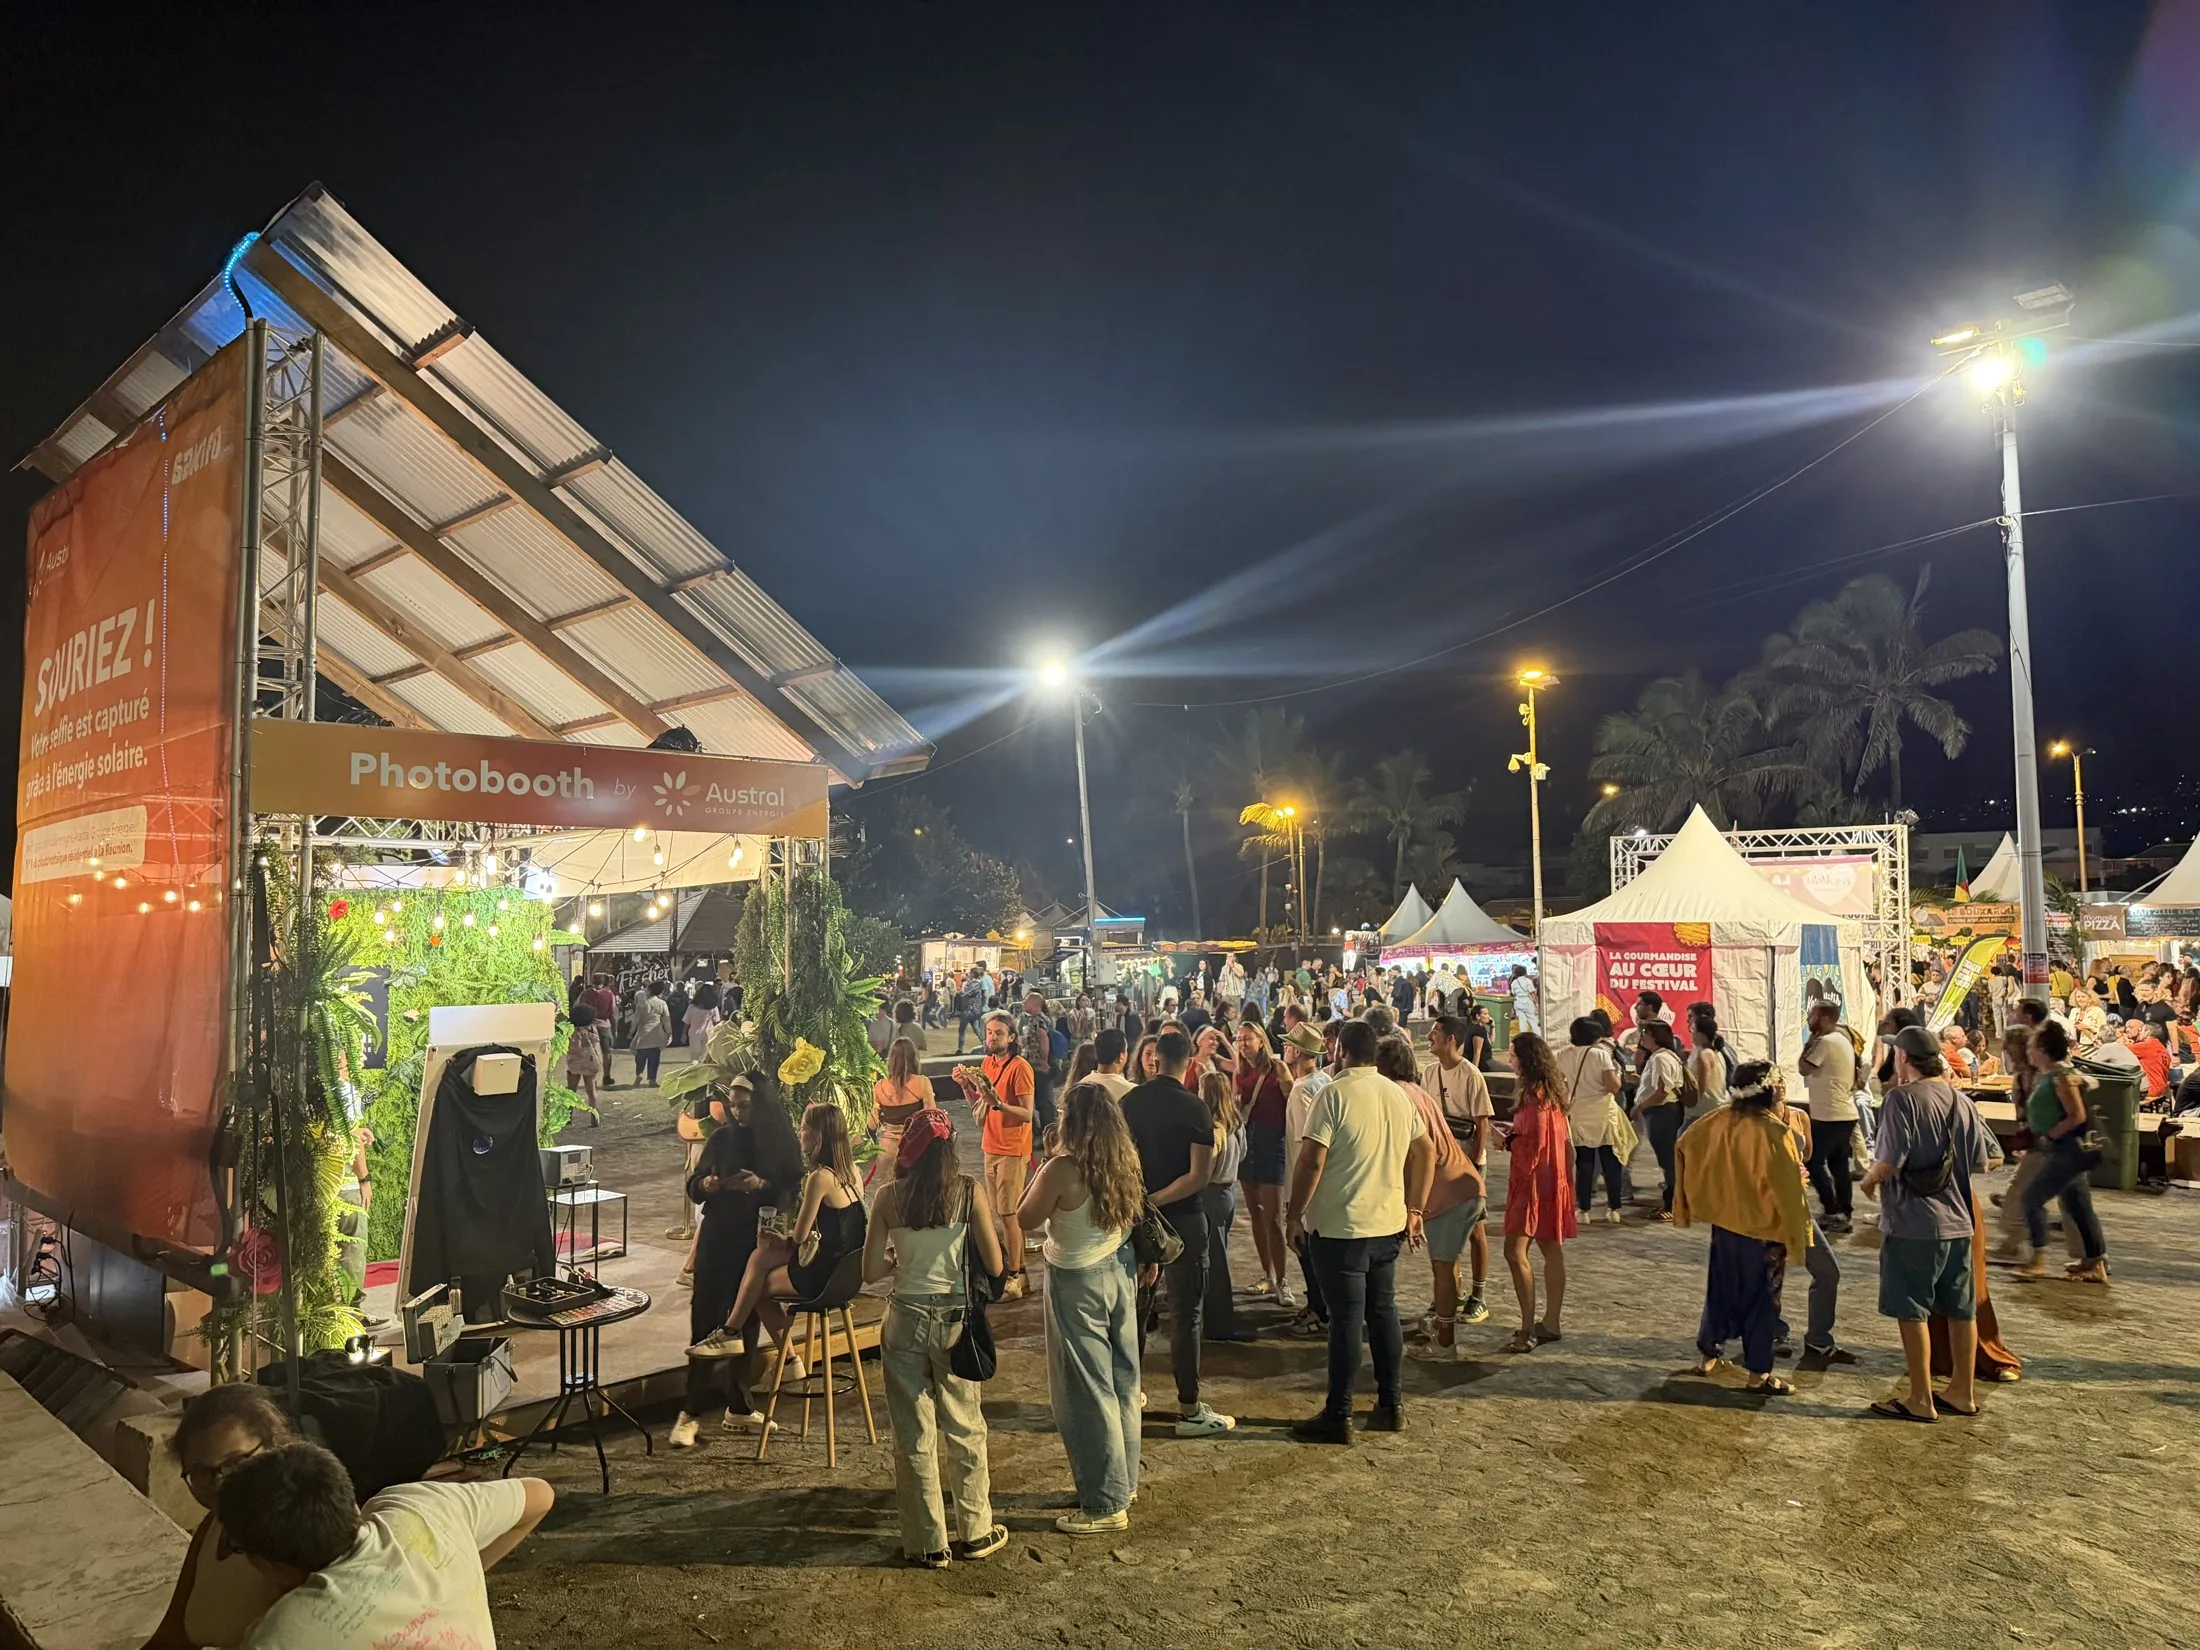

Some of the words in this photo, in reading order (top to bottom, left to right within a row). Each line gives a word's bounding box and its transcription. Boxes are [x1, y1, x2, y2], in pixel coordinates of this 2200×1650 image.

[34, 606, 138, 718] SOURIEZ
[50, 714, 74, 750] selfie
[76, 709, 93, 739] est
[95, 687, 150, 738] capturé
[52, 751, 95, 791] l'énergie
[97, 740, 149, 778] solaire.
[350, 751, 595, 801] Photobooth
[614, 777, 637, 800] by
[705, 782, 785, 807] Austral
[704, 806, 743, 816] GROUPE
[2084, 919, 2121, 931] PIZZA
[1609, 952, 1622, 960] LA
[1623, 952, 1698, 961] GOURMANDISE
[1609, 962, 1636, 977] AU
[1640, 962, 1698, 978] CŒUR
[1609, 978, 1629, 989] DU
[1632, 979, 1699, 991] FESTIVAL
